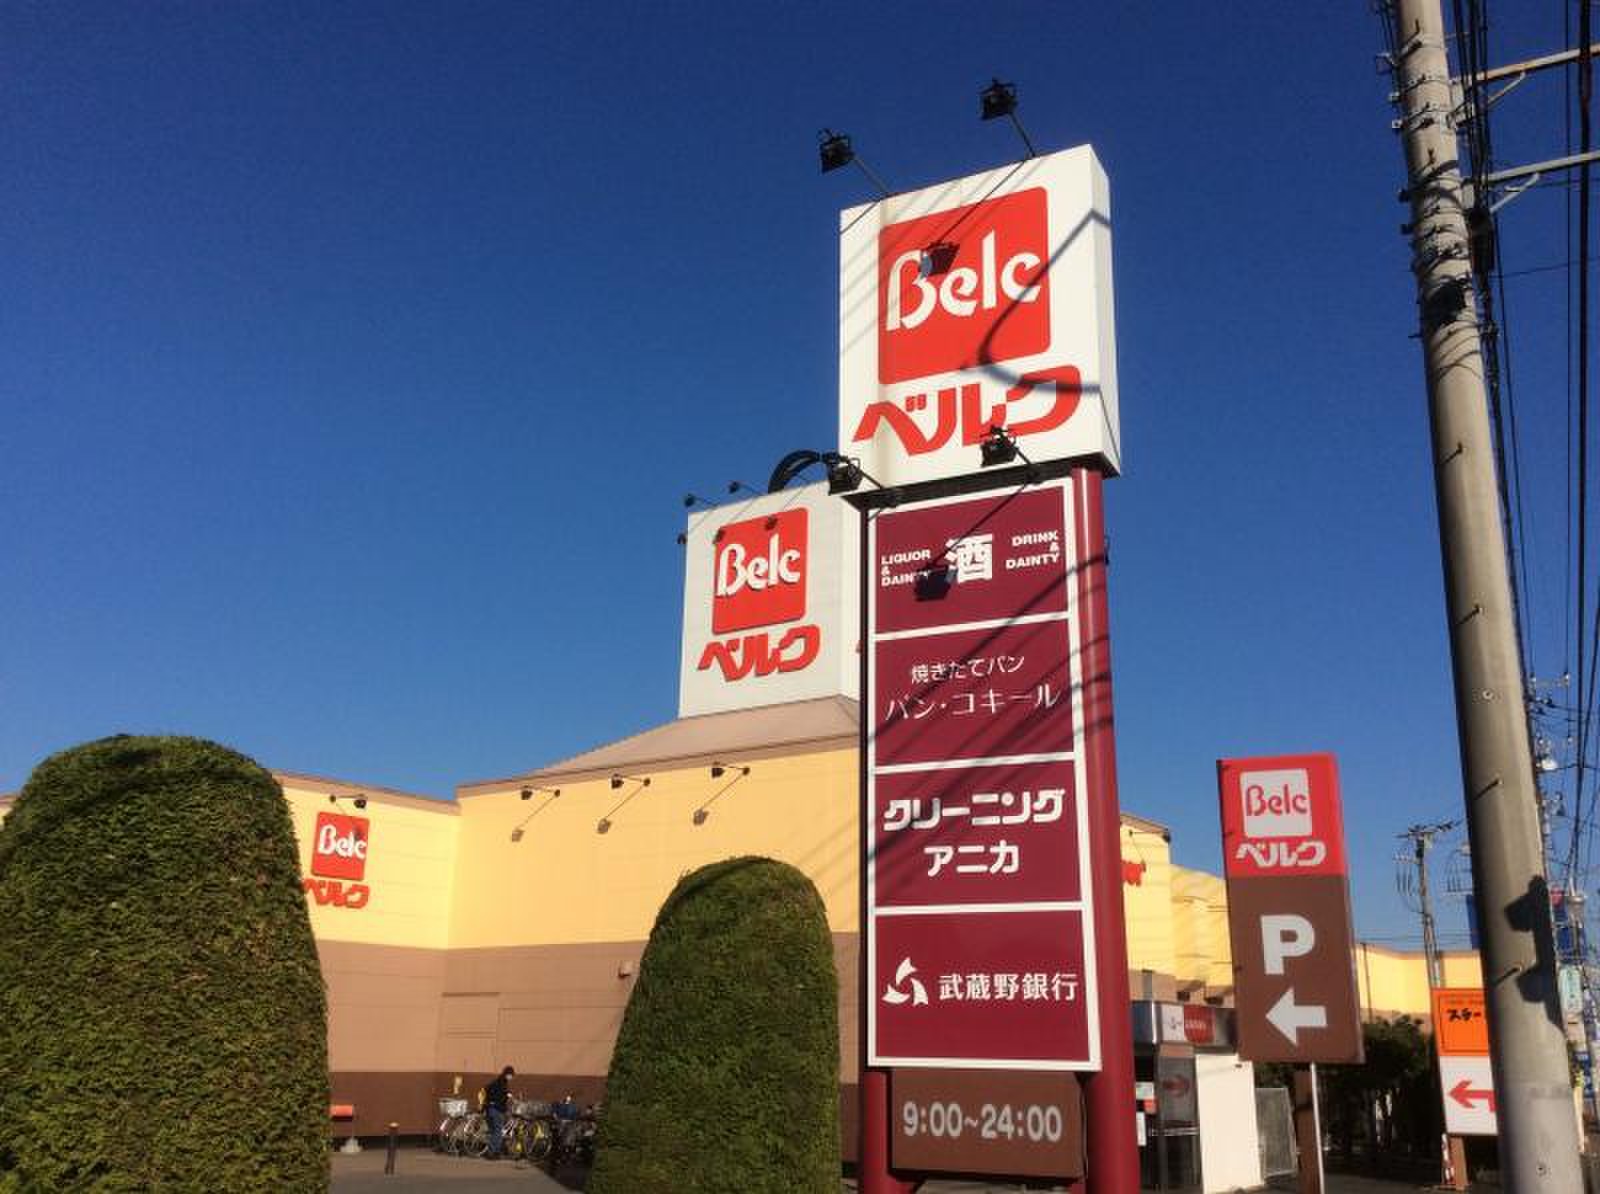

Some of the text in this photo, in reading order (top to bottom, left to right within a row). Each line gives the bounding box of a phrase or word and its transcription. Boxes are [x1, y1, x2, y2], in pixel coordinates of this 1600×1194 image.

[886, 229, 1041, 332] Belc
[852, 364, 1083, 457] ベルク
[1012, 530, 1059, 547] DRINK
[1050, 541, 1060, 552] &
[716, 533, 801, 597] Belc
[881, 549, 931, 565] LIQUOR
[881, 566, 890, 576] &
[945, 533, 993, 584] 酒
[1005, 552, 1060, 570] DAINTY
[881, 569, 932, 587] DAIN
[697, 624, 821, 682] ベルク
[911, 655, 1025, 684] 焼きたてパン
[883, 788, 1066, 832] クリーニング
[1246, 785, 1308, 816] Belc
[317, 824, 367, 859] Belc
[1235, 841, 1327, 868] ベルク
[924, 839, 1020, 877] アニカ
[1260, 914, 1315, 976] P
[938, 972, 1079, 1001] 武蔵野銀行
